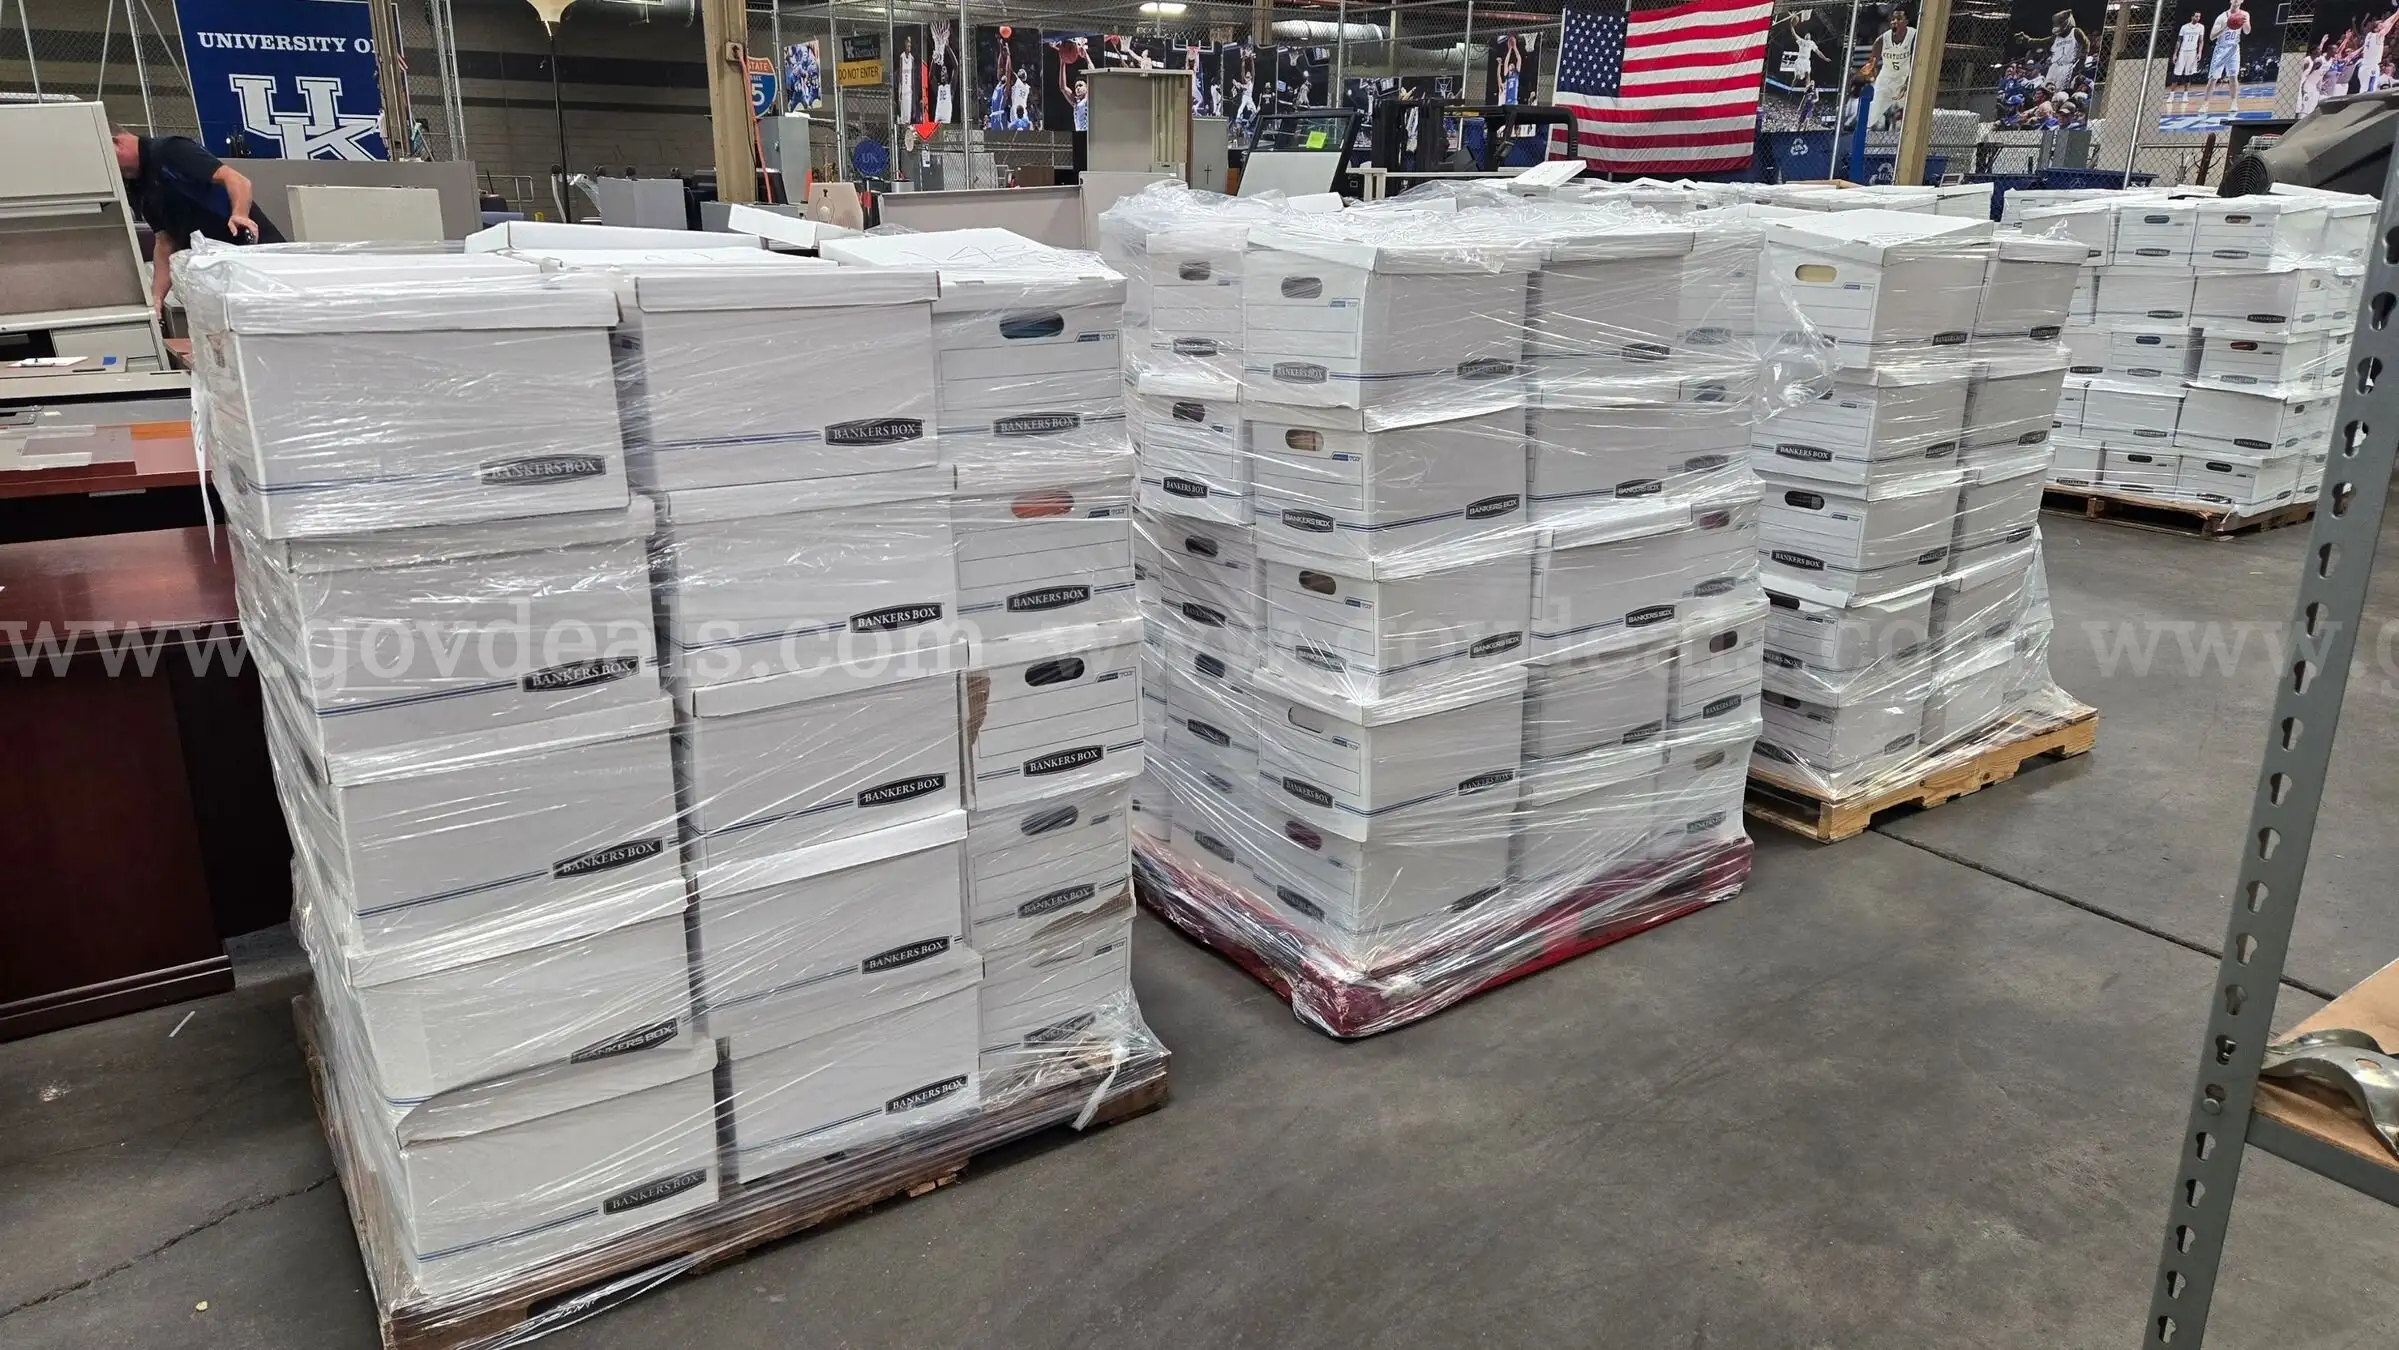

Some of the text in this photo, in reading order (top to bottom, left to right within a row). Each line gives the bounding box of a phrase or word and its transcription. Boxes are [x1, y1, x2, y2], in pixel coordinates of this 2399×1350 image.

[197, 32, 346, 53] UNIVERSITY
[838, 65, 879, 80] DO NOT ENTER
[833, 423, 916, 440] BANKERS BOX
[1000, 415, 1074, 432] BANKERS BOX
[1780, 446, 1829, 460] BANKERS BOX
[565, 459, 597, 473] BOX
[1166, 480, 1205, 495] BANKERS BOX
[1469, 498, 1518, 515] BANKERS BOX
[1284, 513, 1331, 529] BANKERS BOX
[1775, 552, 1821, 569] BANKERS BOX
[1013, 588, 1085, 608] BANKERS BOX
[857, 607, 937, 628] BANKERS BOX
[1628, 608, 1673, 624] BANKERS BOX
[1473, 635, 1521, 655] BANKERS BOX
[532, 660, 632, 687] BANKERS BOX
[1029, 749, 1099, 772] BANKERS BOX
[864, 777, 940, 802] BANKERS BOX
[1286, 780, 1329, 805] BANKERS BOX
[1463, 775, 1495, 792] BANKERS
[562, 842, 656, 873] BANKERS BOX
[1024, 887, 1090, 913] BANKERS BOX
[868, 941, 944, 969] BANKERS BOX
[645, 1025, 675, 1042] BOX
[892, 1078, 964, 1110] BANKERS BOX
[611, 1174, 700, 1209] BANKERS BOX
